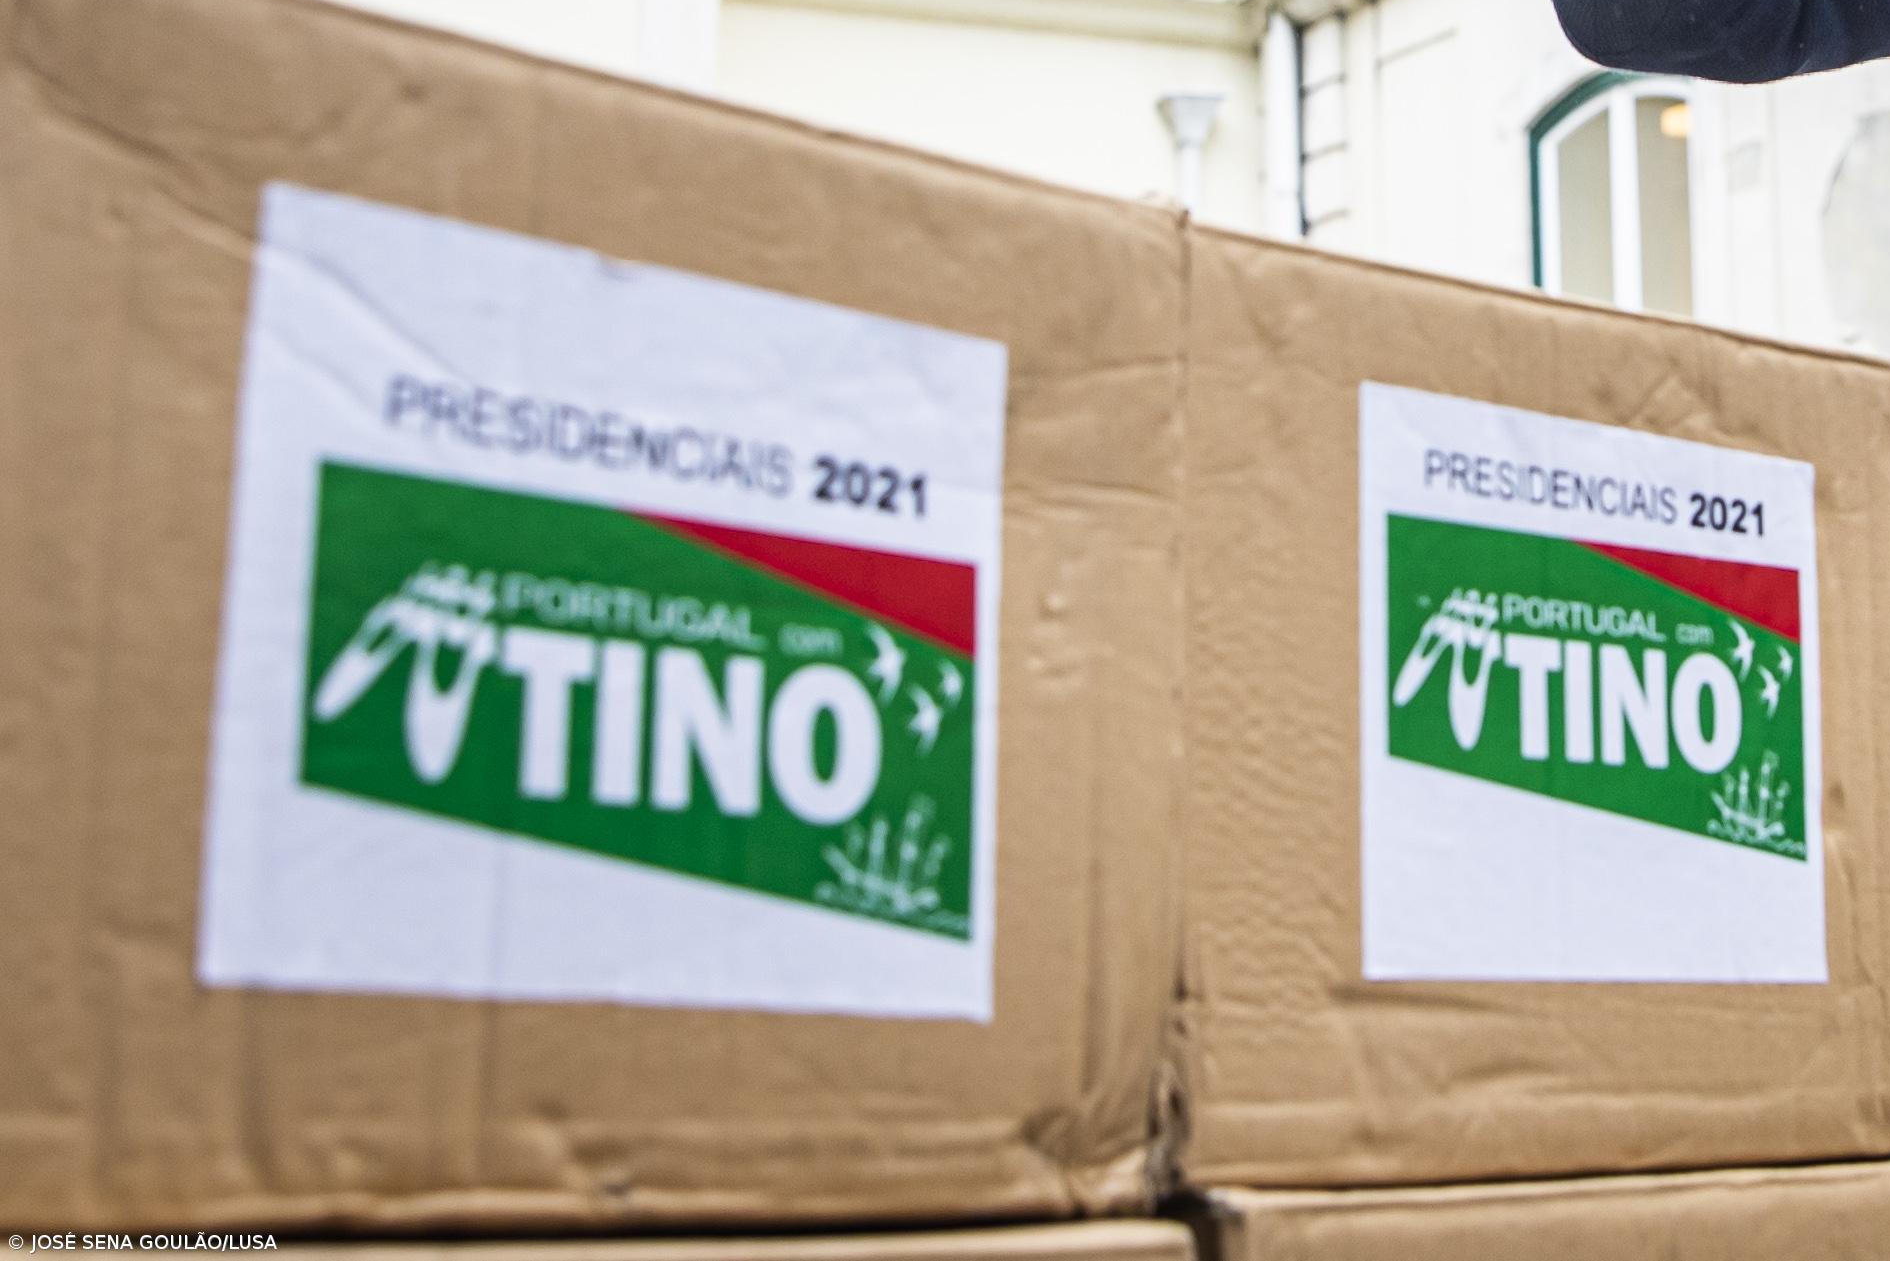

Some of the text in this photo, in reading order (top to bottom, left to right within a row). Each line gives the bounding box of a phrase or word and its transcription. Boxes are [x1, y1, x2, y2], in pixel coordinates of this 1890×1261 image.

[385, 376, 929, 519] PRESIDENCIAIS 2021
[1423, 447, 1765, 537] PRESIDENCIAIS 2021
[502, 572, 764, 650] PORTUGAL
[1502, 592, 1667, 642] PORTUGAL
[502, 628, 883, 825] TINO
[1505, 634, 1743, 774] TINO
